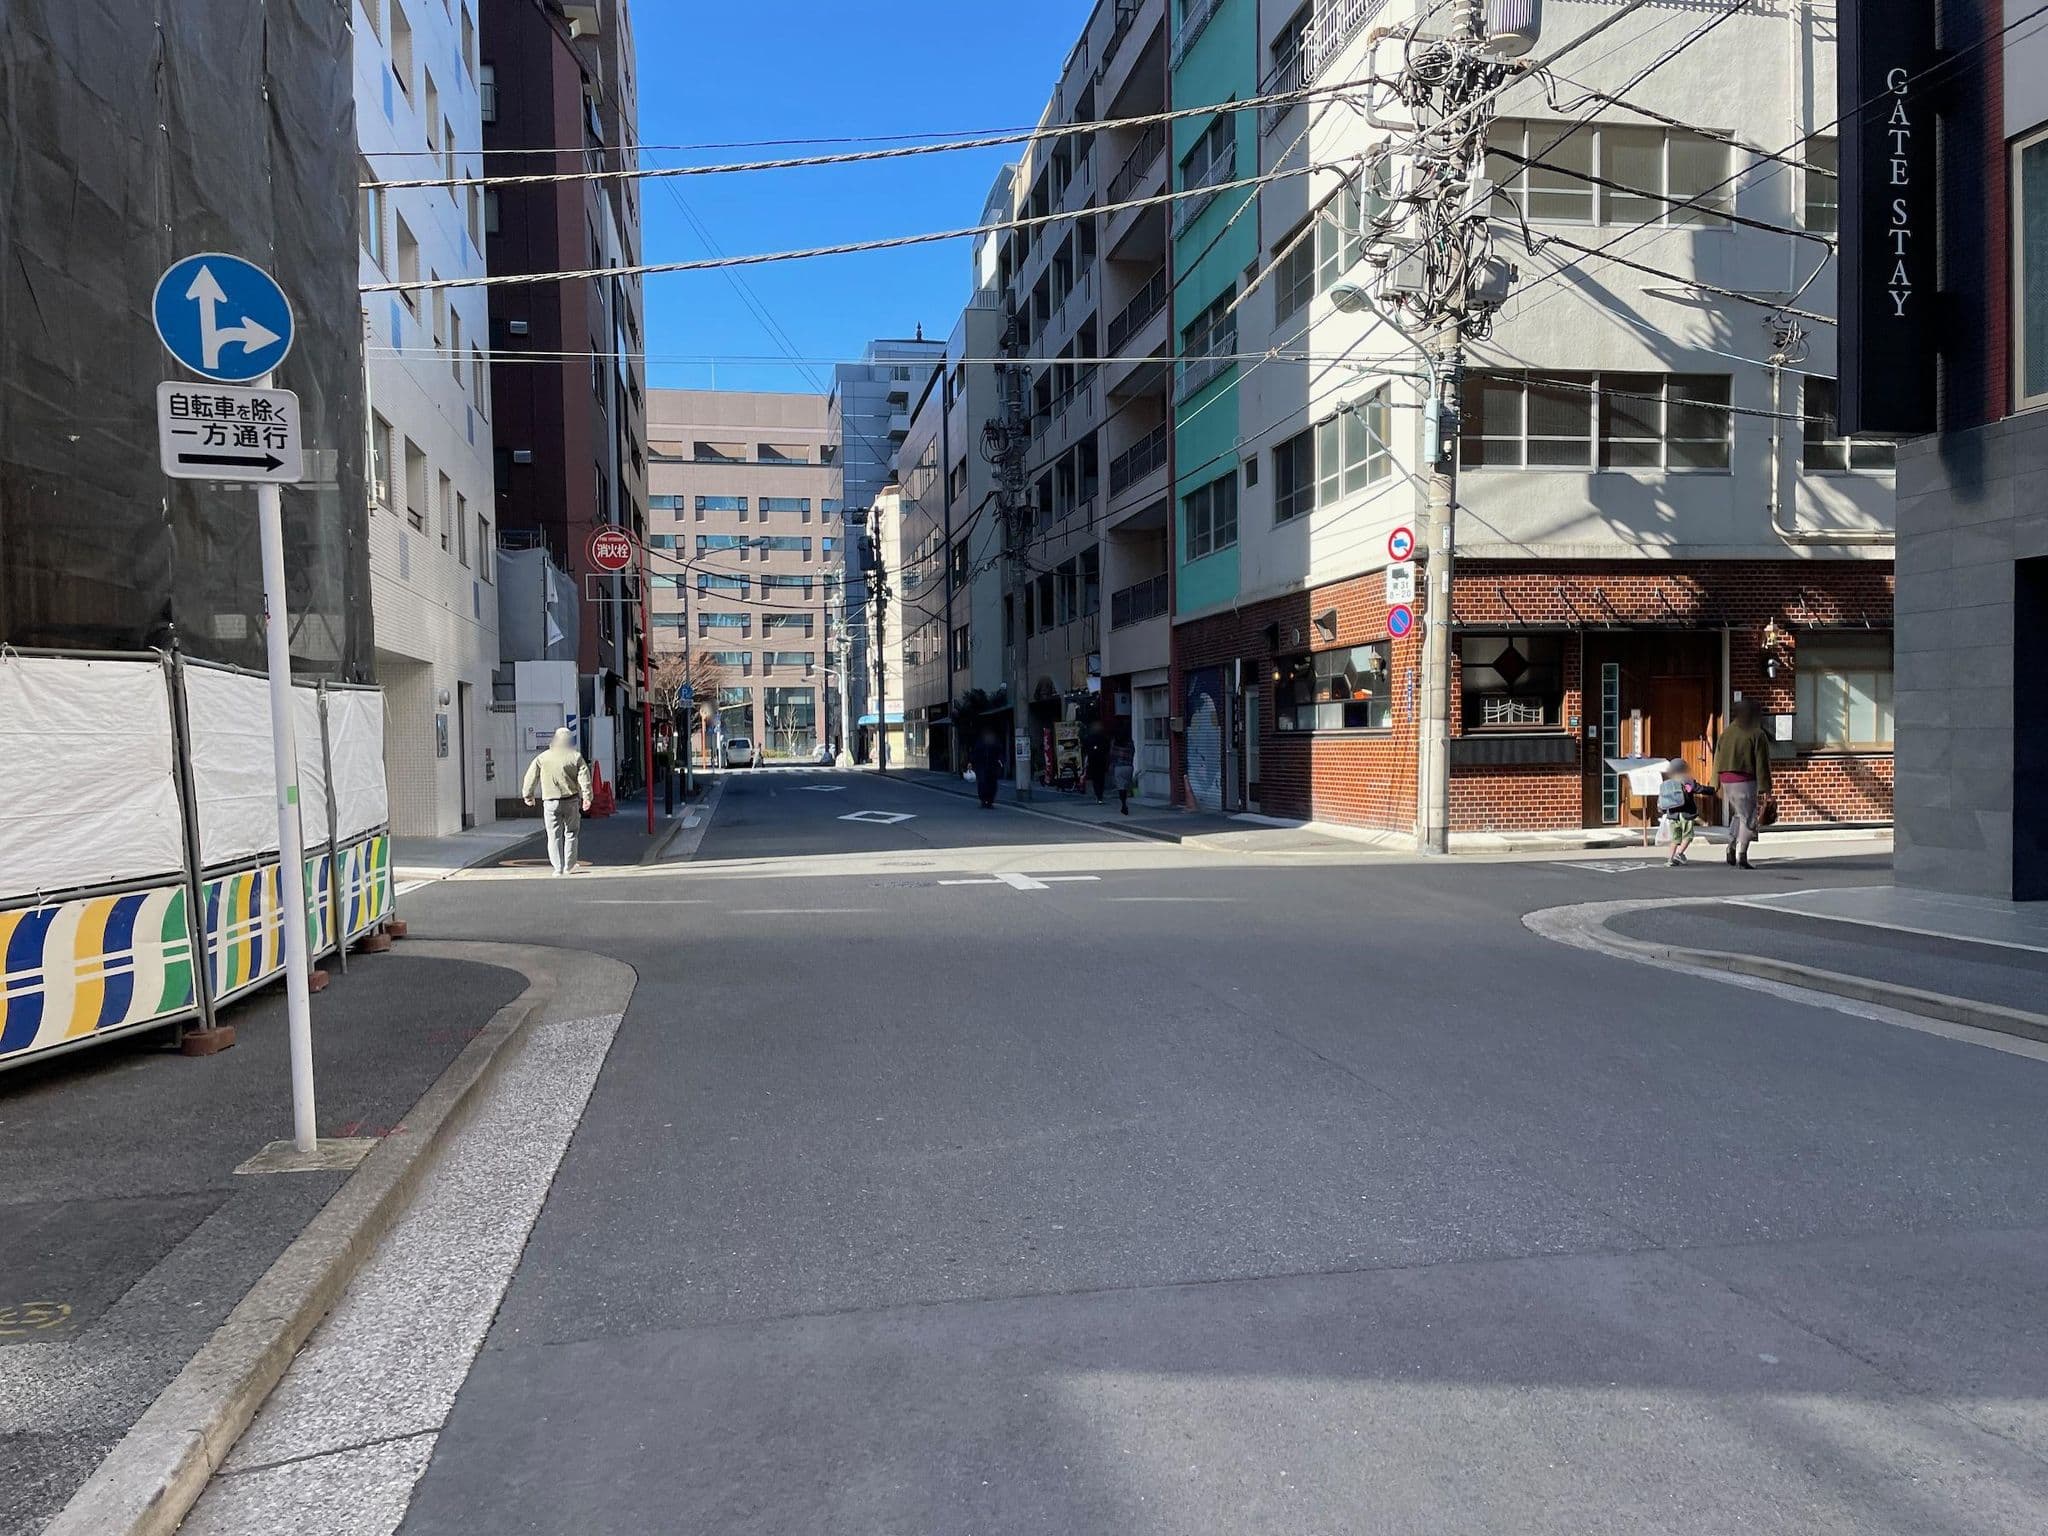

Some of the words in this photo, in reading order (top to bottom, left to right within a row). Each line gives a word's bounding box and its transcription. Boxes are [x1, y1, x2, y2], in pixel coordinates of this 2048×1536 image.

[1886, 67, 1911, 185] GATE
[1887, 198, 1912, 316] STAY
[169, 392, 287, 423] 自転車を除く
[171, 422, 289, 450] 一方通行
[597, 543, 629, 559] 消火栓
